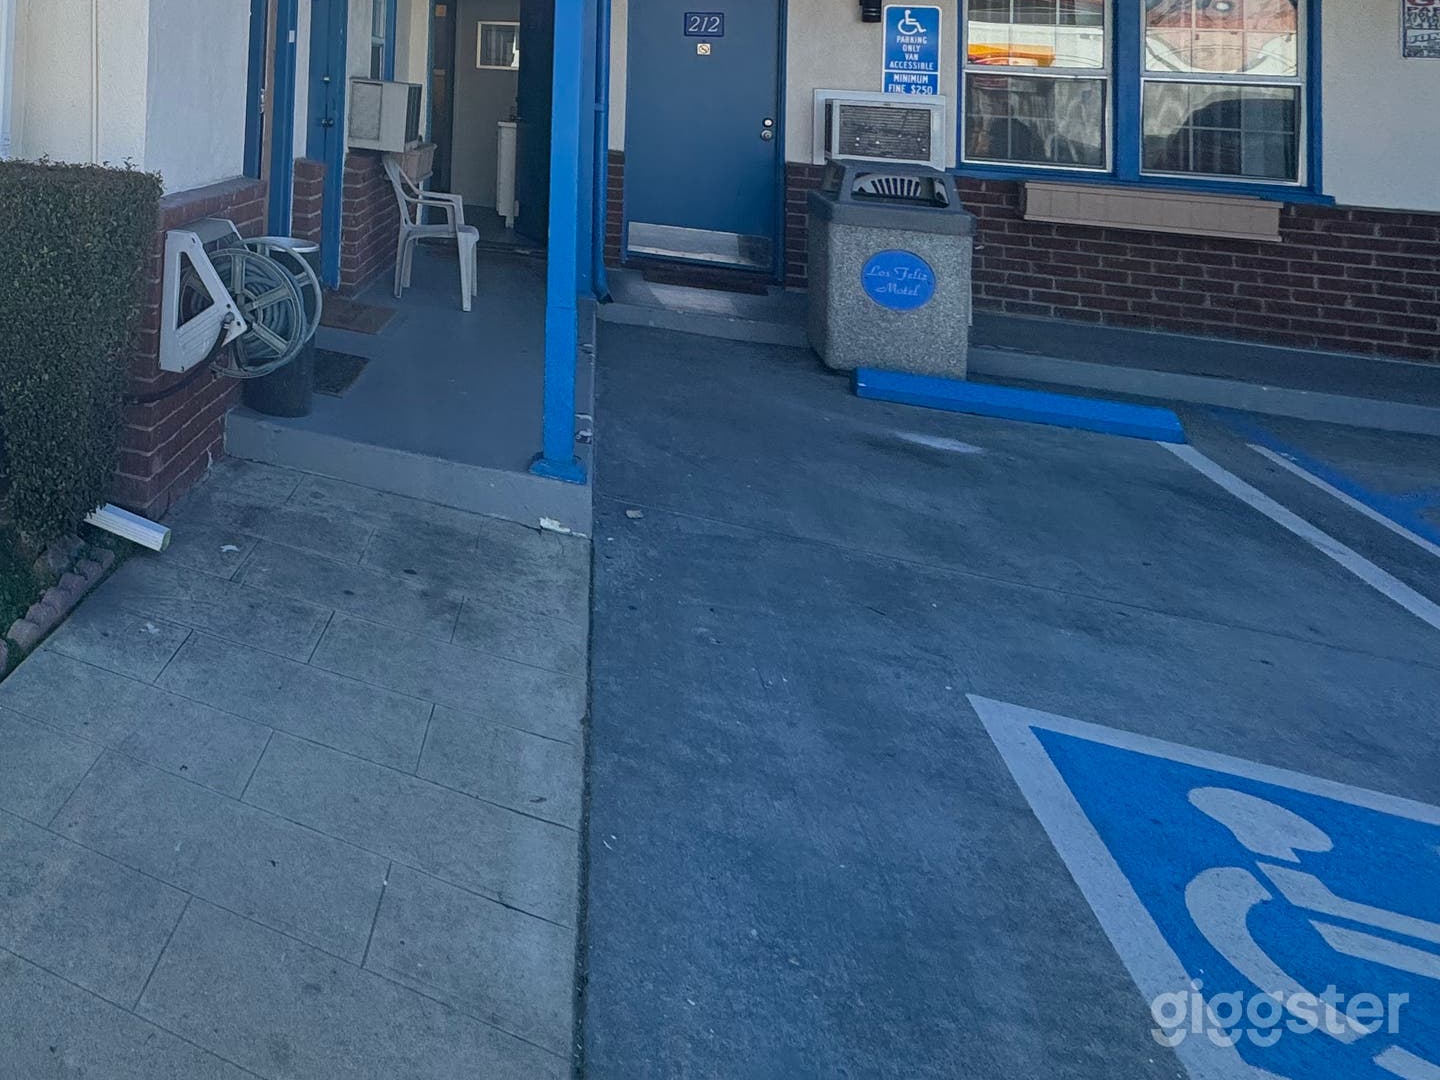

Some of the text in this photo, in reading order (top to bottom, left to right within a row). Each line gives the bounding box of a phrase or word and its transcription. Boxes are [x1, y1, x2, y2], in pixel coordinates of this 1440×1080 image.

[688, 15, 720, 32] 212
[896, 35, 928, 44] PARKING
[902, 44, 921, 52] ONLY
[905, 53, 919, 61] VAN
[889, 61, 934, 70] ACCESSIBLE
[893, 74, 929, 84] MINIMUM
[888, 84, 933, 95] FINE $250
[866, 265, 928, 281] Los Feliz
[874, 282, 921, 297] Motel
